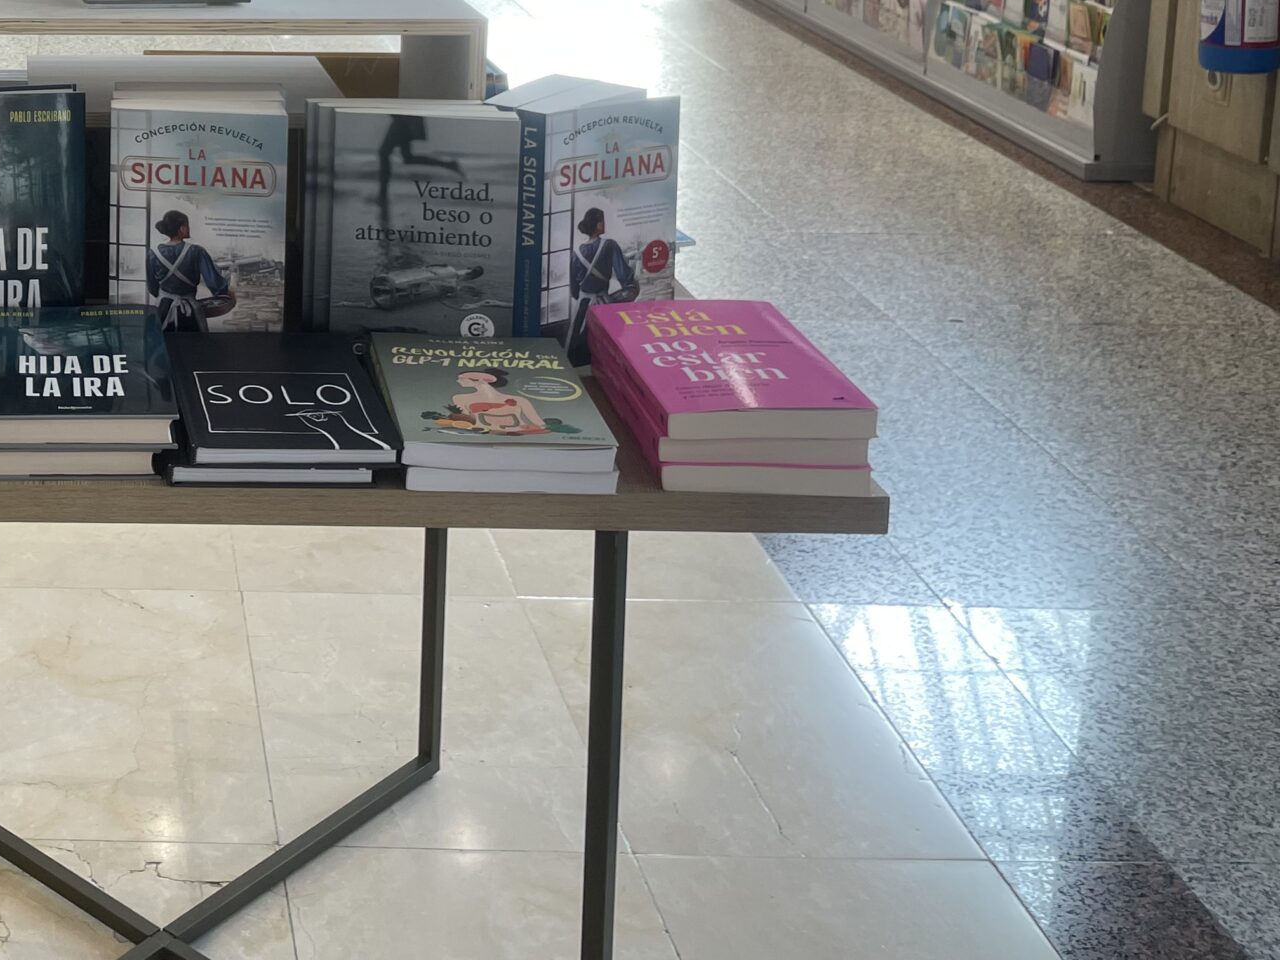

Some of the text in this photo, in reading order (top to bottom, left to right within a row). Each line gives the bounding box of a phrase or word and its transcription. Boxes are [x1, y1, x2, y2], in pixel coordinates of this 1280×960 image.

[9, 110, 71, 123] PABLO ESCRIBANO
[134, 122, 264, 151] CONCEPCIÓN REVUELTA
[524, 127, 537, 149] LA
[563, 115, 664, 146] CONCEPCIÓN REVUELTA
[188, 149, 207, 161] LA
[605, 141, 620, 154] LA
[130, 162, 267, 190] SICILIANA
[559, 152, 665, 187] SICILIANA
[414, 180, 494, 204] Verdad,
[521, 155, 536, 246] SICILIANA
[423, 203, 493, 224] beso o
[355, 224, 492, 248] atrevimiento
[17, 227, 49, 270] DE
[617, 308, 712, 325] Está
[646, 323, 747, 338] bien
[391, 346, 531, 359] REVOLUCIÓN
[640, 340, 699, 354] no
[18, 354, 129, 376] HIJA DE
[392, 355, 565, 370] GLP-1 NATURAL
[652, 351, 767, 368] estar
[681, 366, 790, 382] bien
[25, 377, 126, 397] LA IRA
[207, 384, 352, 406] SOLO
